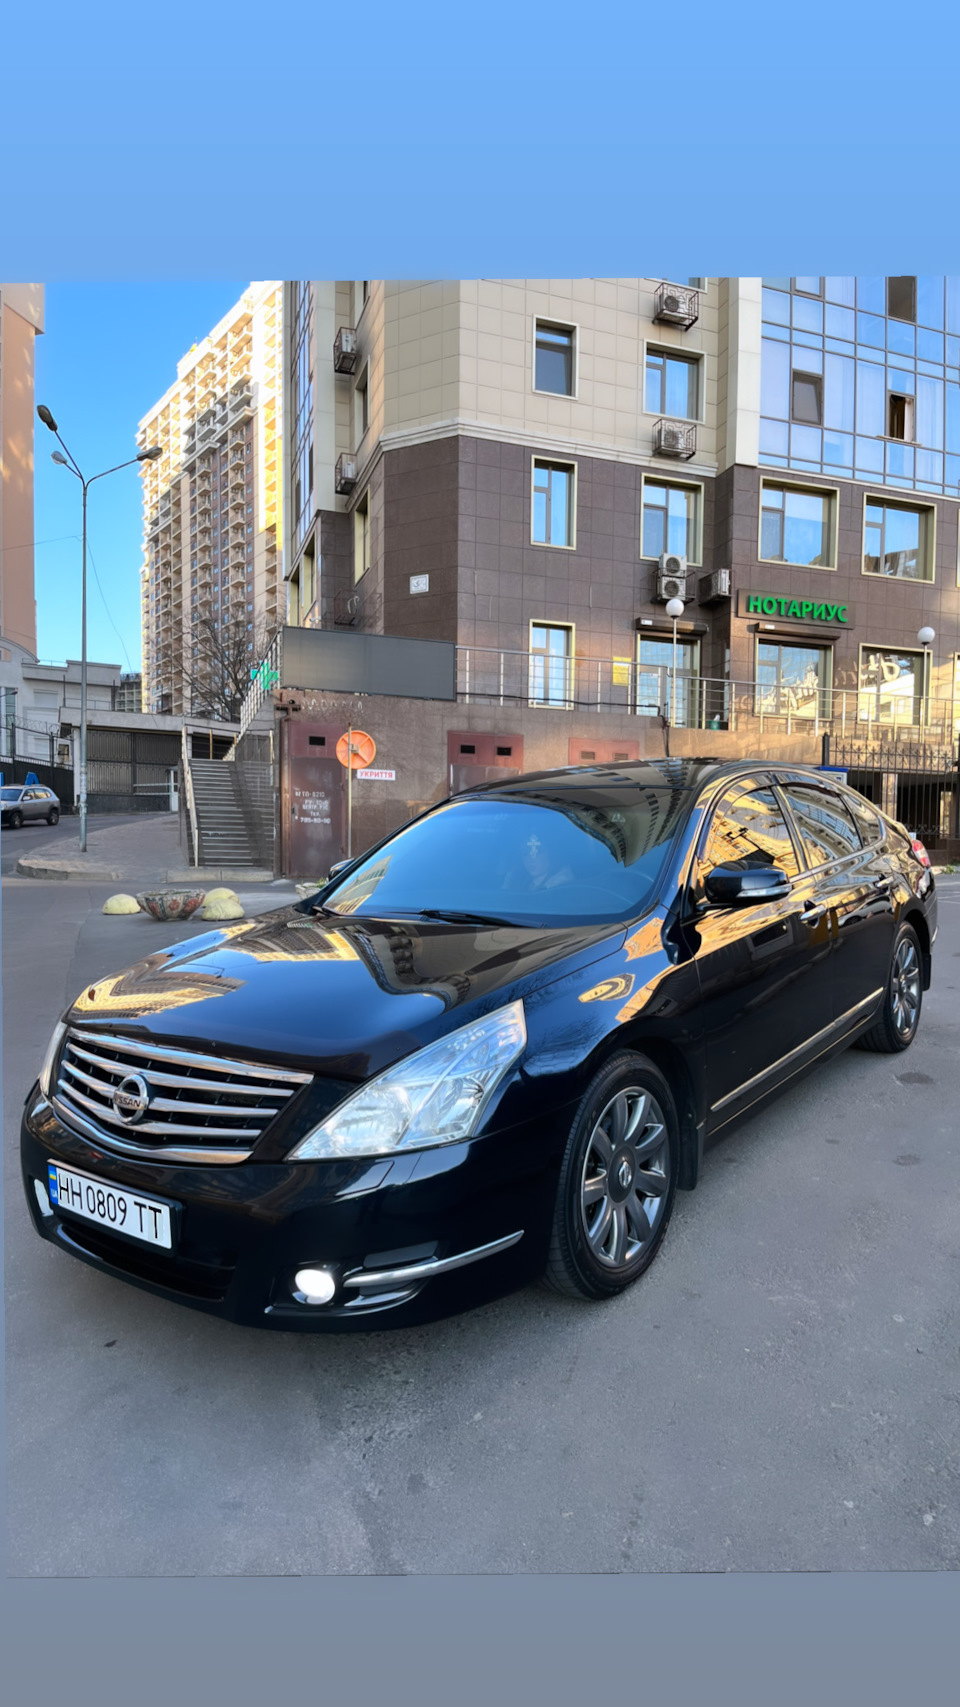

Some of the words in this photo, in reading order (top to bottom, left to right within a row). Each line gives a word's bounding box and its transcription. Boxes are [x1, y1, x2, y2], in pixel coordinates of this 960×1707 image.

[748, 595, 848, 623] НОТАРИУС
[359, 770, 393, 779] УКРИТТЯ
[58, 1174, 83, 1210] HH
[86, 1185, 127, 1226] 0809
[134, 1201, 162, 1239] TT
